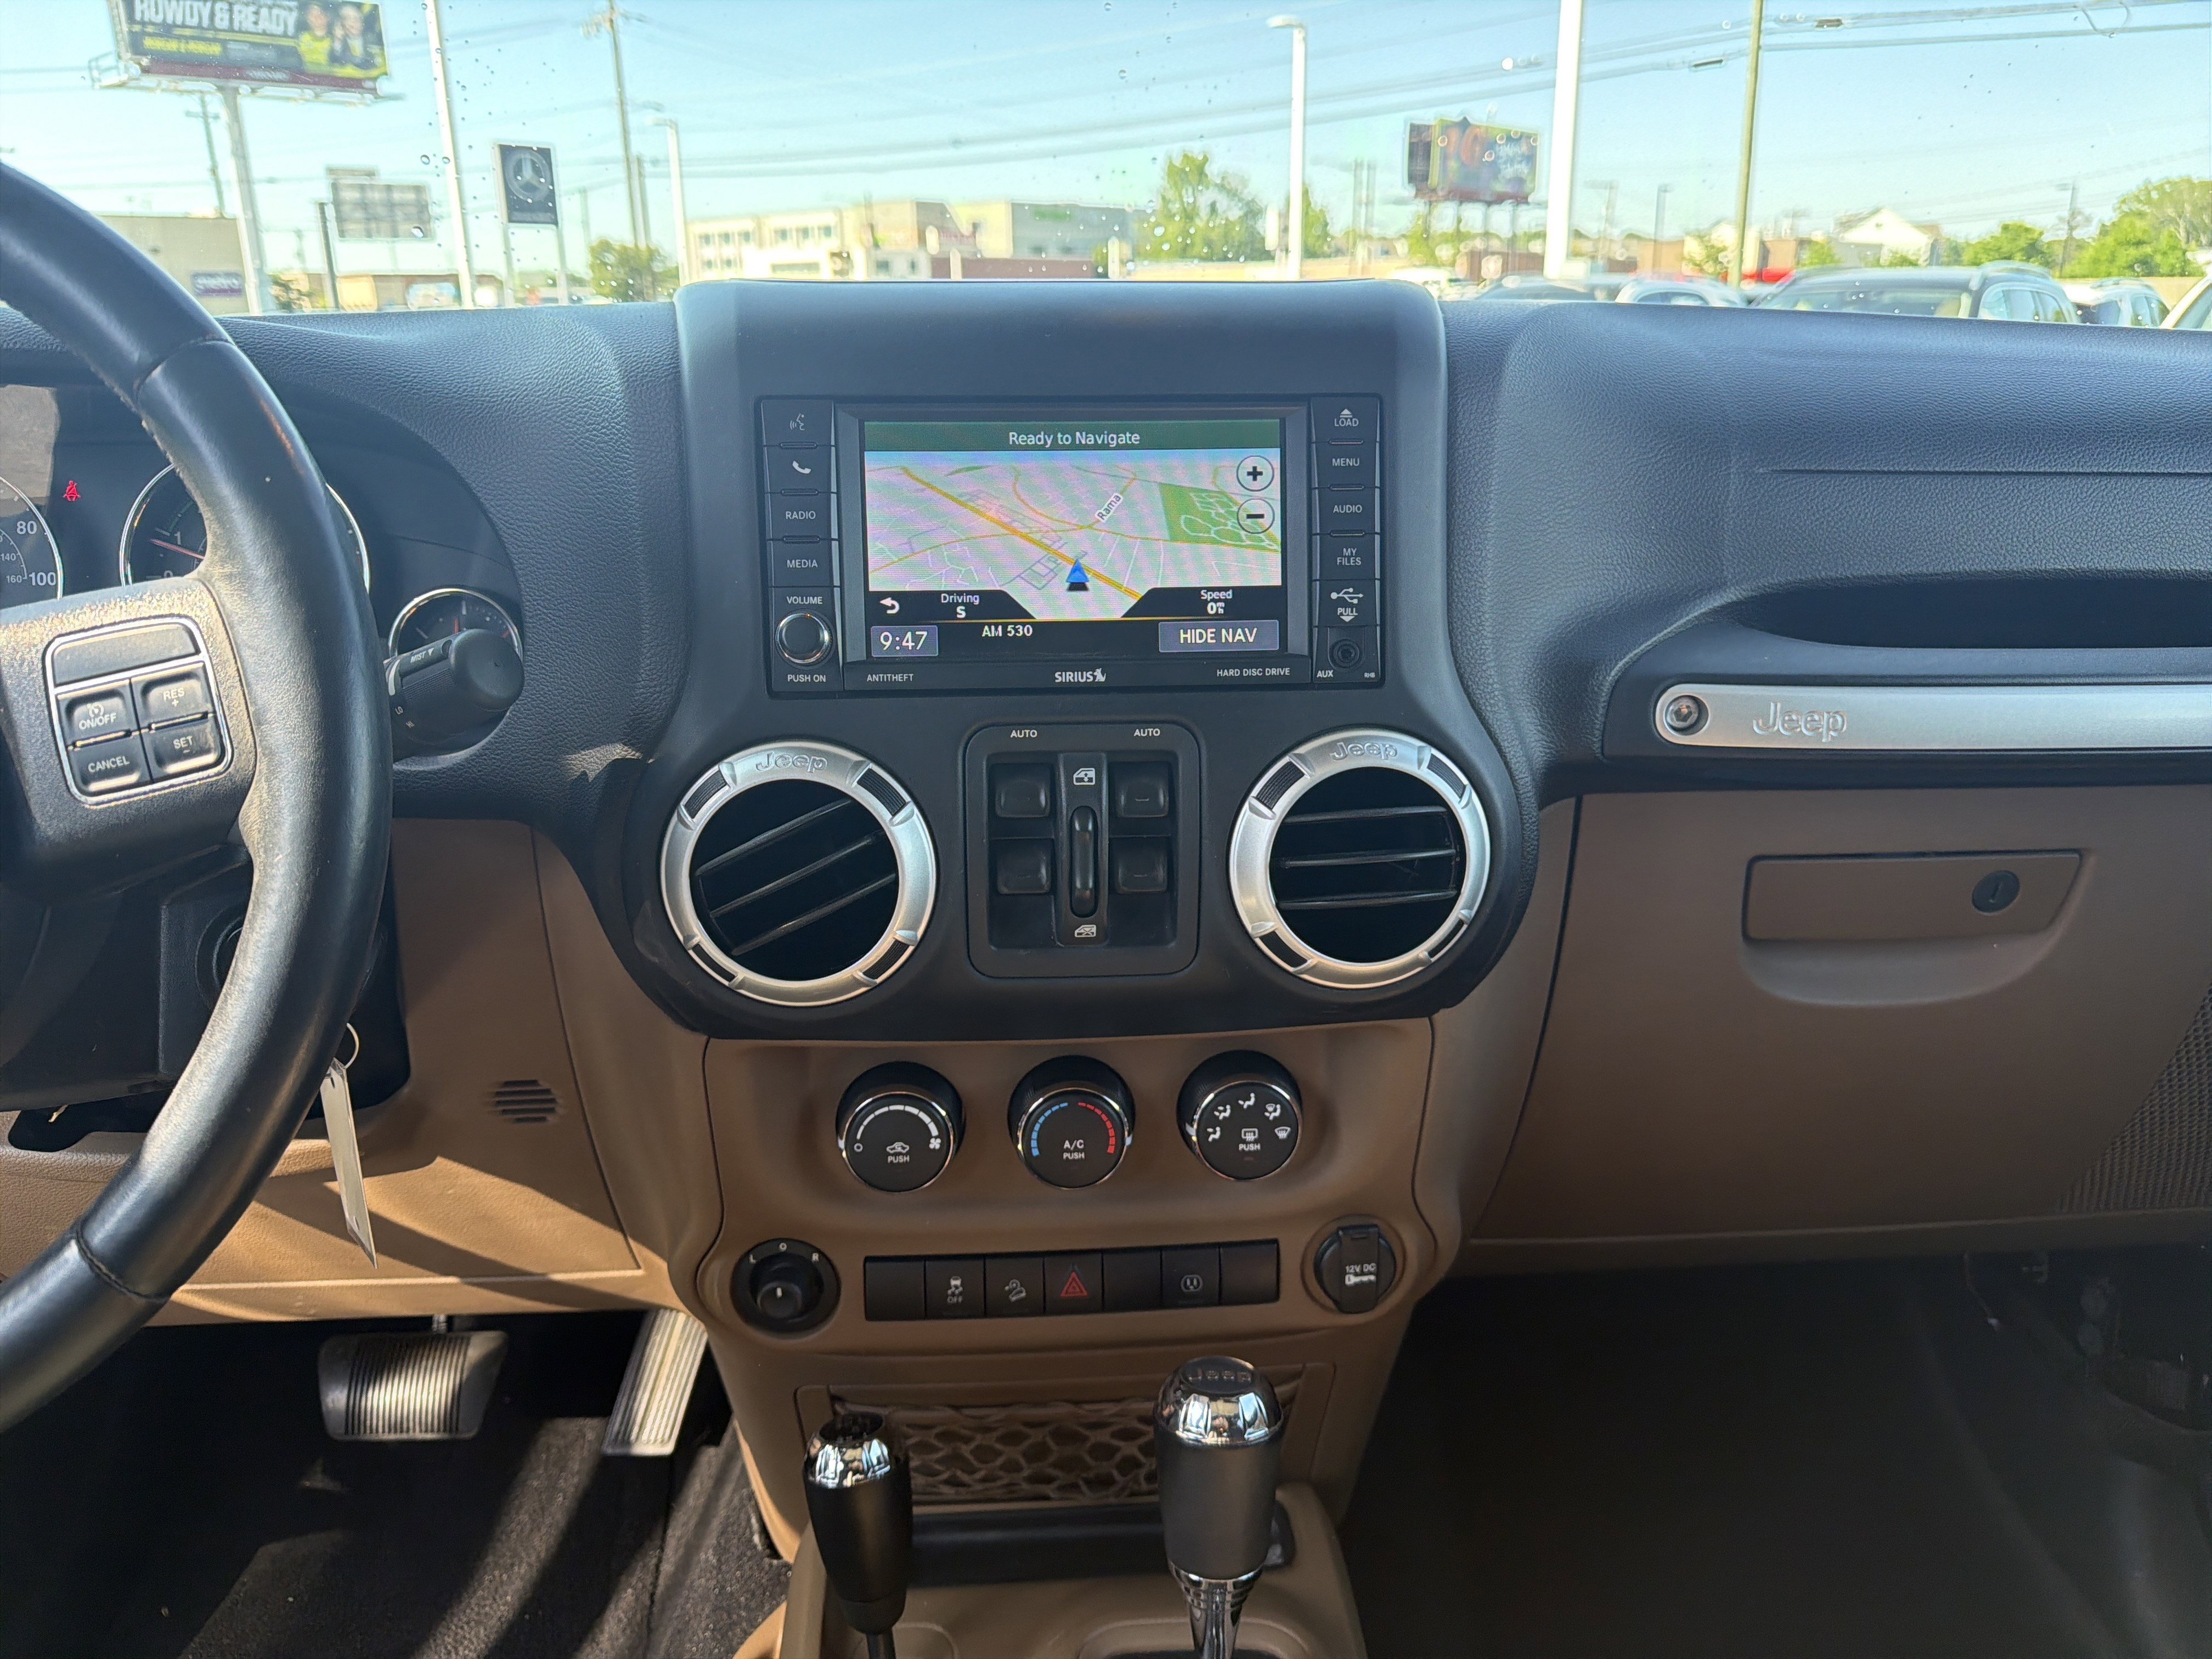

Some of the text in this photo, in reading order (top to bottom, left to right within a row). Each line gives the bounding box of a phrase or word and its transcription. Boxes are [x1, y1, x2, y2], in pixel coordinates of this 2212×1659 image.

[233, 4, 297, 37] READY
[1335, 419, 1359, 427] LOAD
[1009, 431, 1141, 448] Ready to Navigate
[1332, 458, 1360, 466] MENU
[1098, 493, 1122, 522] Rama
[1333, 504, 1363, 514] AUDIO
[786, 510, 816, 520] RADIO
[16, 521, 37, 535] 80
[1, 552, 16, 561] 140
[1343, 548, 1357, 556] MY
[787, 559, 818, 568] MEDIA
[1336, 557, 1362, 566] FILES
[6, 575, 22, 583] 160
[29, 572, 57, 586] 100
[941, 592, 980, 605] Driving
[1200, 589, 1233, 601] Speed
[786, 596, 823, 605] VOLUME
[956, 606, 966, 618] S
[1337, 607, 1358, 616] PULL
[981, 624, 1033, 637] AM 530
[880, 631, 928, 651] 9:47
[1180, 628, 1257, 644] HIDE NAV
[410, 651, 427, 663] MIST
[1054, 671, 1093, 682] SIRIUS
[1217, 667, 1290, 677] HARD DISC DRIVE
[1316, 669, 1334, 678] AUX
[787, 674, 826, 682] PUSH ON
[866, 674, 914, 682] ANTITHEFT
[162, 689, 185, 699] RES
[78, 713, 117, 730] ON/OFF
[1752, 701, 1847, 743] Jeep
[1010, 729, 1037, 738] AUTO
[1133, 728, 1161, 737] AUTO
[173, 735, 193, 750] SET
[1329, 740, 1398, 761] Jeep
[88, 755, 130, 772] CANCEL
[755, 751, 828, 774] Jeep
[1063, 1139, 1085, 1150] A/C
[1238, 1143, 1261, 1151] PUSH
[887, 1155, 910, 1163] PUSH
[1063, 1152, 1085, 1160] PUSH
[749, 1254, 757, 1263] L
[811, 1252, 819, 1262] R
[1345, 1262, 1376, 1273] 12V DC
[946, 1295, 963, 1304] OFF
